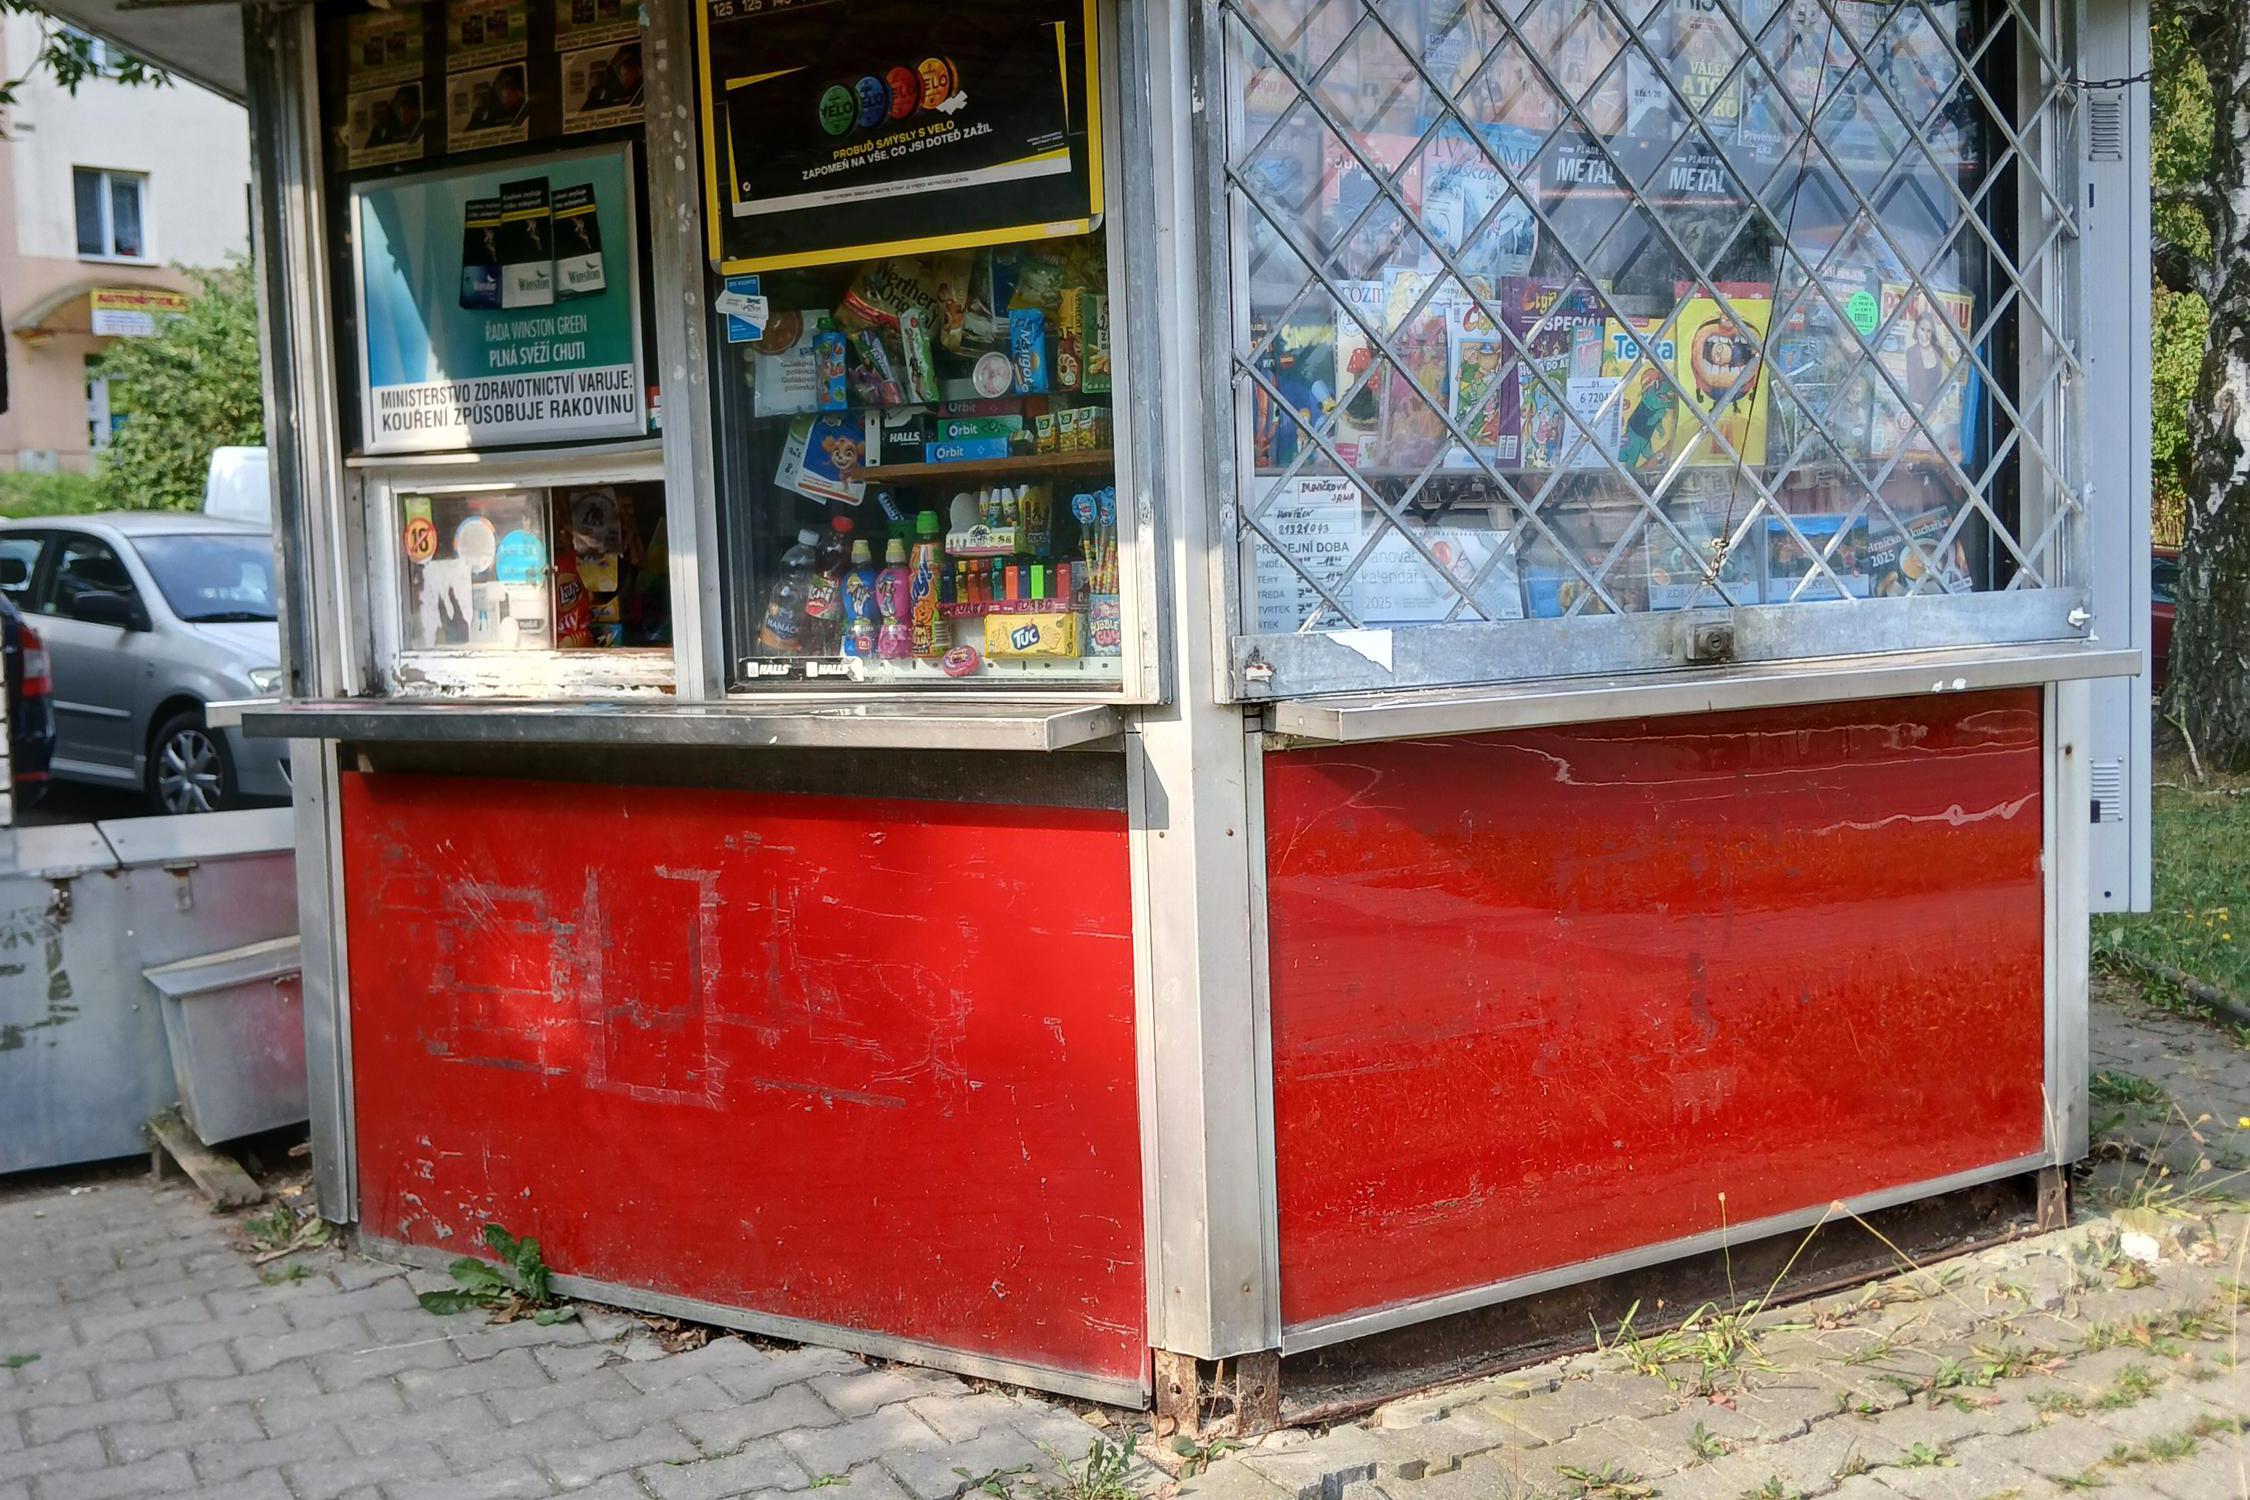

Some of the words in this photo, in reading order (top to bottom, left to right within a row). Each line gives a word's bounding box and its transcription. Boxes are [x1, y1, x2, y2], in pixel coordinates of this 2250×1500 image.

[924, 74, 948, 90] ELO
[821, 101, 852, 118] VELO
[833, 140, 874, 160] PROBUĎ
[876, 131, 917, 149] SMYSLY
[918, 127, 926, 138] S
[927, 120, 955, 136] VELO
[802, 159, 850, 181] ZAPOMEŇ
[850, 154, 866, 168] NA
[891, 144, 907, 158] CO
[908, 140, 925, 153] JSI
[926, 129, 962, 148] DOTEĎ
[963, 121, 993, 138] ZAŽIL
[1556, 157, 1617, 185] METAL
[1668, 167, 1727, 193] METAL
[485, 321, 511, 343] ŘADA
[511, 318, 555, 341] WINSTON
[557, 315, 588, 335] GREEN
[489, 345, 518, 368] PLNÁ
[519, 341, 551, 365] SVĚŽÍ
[552, 341, 586, 362] CHUTI
[1613, 335, 1674, 362] Teka
[381, 384, 470, 410] MINISTERSTVO
[474, 373, 575, 401] ZDRAVOTNICTVÍ
[578, 369, 634, 394] VARUJE:
[383, 408, 449, 432] KOUŘENÍ
[453, 400, 544, 426] ZPŮSOBUJE
[550, 394, 634, 419] RAKOVINU
[948, 401, 977, 414] Orbit
[889, 431, 921, 443] HALLS
[948, 422, 978, 437] Orbit
[936, 446, 964, 459] Orbit
[411, 525, 429, 553] 18
[1316, 541, 1350, 554] DOBA
[1870, 550, 1895, 568] 2025
[1257, 605, 1290, 614] TVRTEK
[1013, 627, 1038, 649] TUC
[759, 663, 790, 676] HALLS
[818, 663, 850, 675] HALLS
